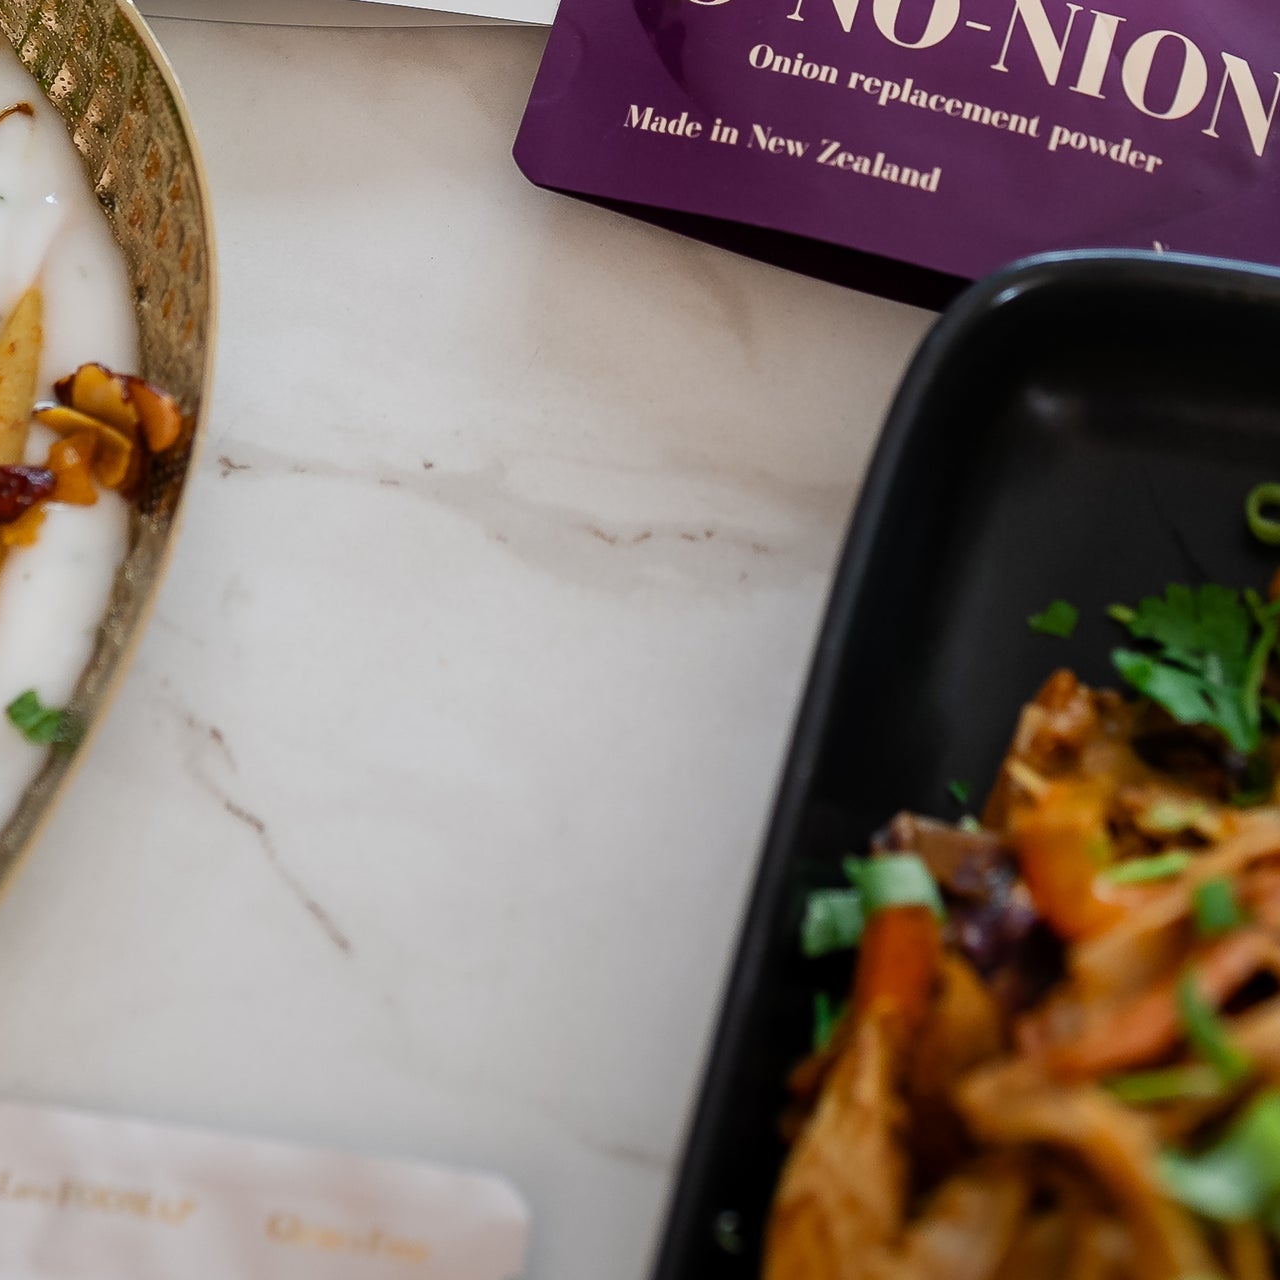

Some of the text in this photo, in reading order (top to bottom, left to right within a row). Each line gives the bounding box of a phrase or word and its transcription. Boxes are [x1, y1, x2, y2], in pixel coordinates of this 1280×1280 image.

[623, 104, 943, 194] Made in New Zealand
[748, 42, 1164, 176] Onion replacement powder
